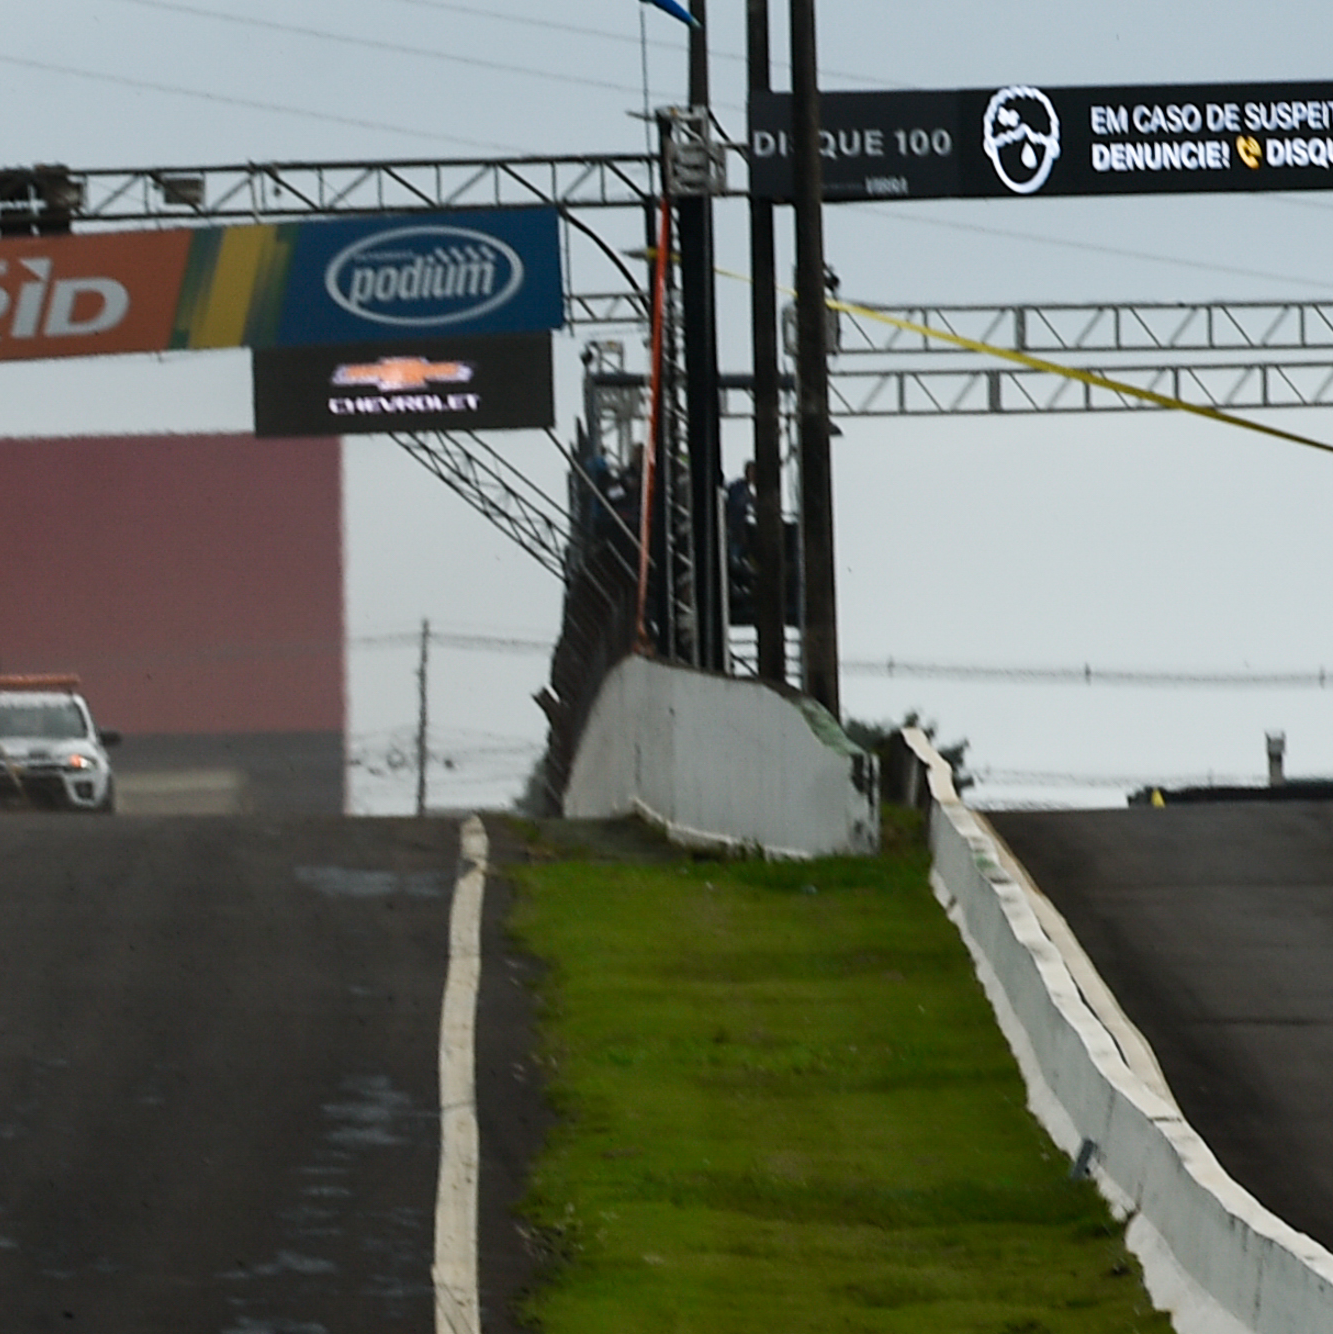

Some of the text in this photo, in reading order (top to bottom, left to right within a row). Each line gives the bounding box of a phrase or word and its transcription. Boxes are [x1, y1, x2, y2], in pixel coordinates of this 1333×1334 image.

[1090, 104, 1129, 134] EM
[1132, 103, 1202, 134] CASO
[1206, 102, 1242, 132] DE
[753, 129, 952, 159] DIQUE 100
[1092, 140, 1231, 172] DENUNCIE!
[350, 254, 495, 303] podium
[329, 394, 480, 414] CHEVROLET
